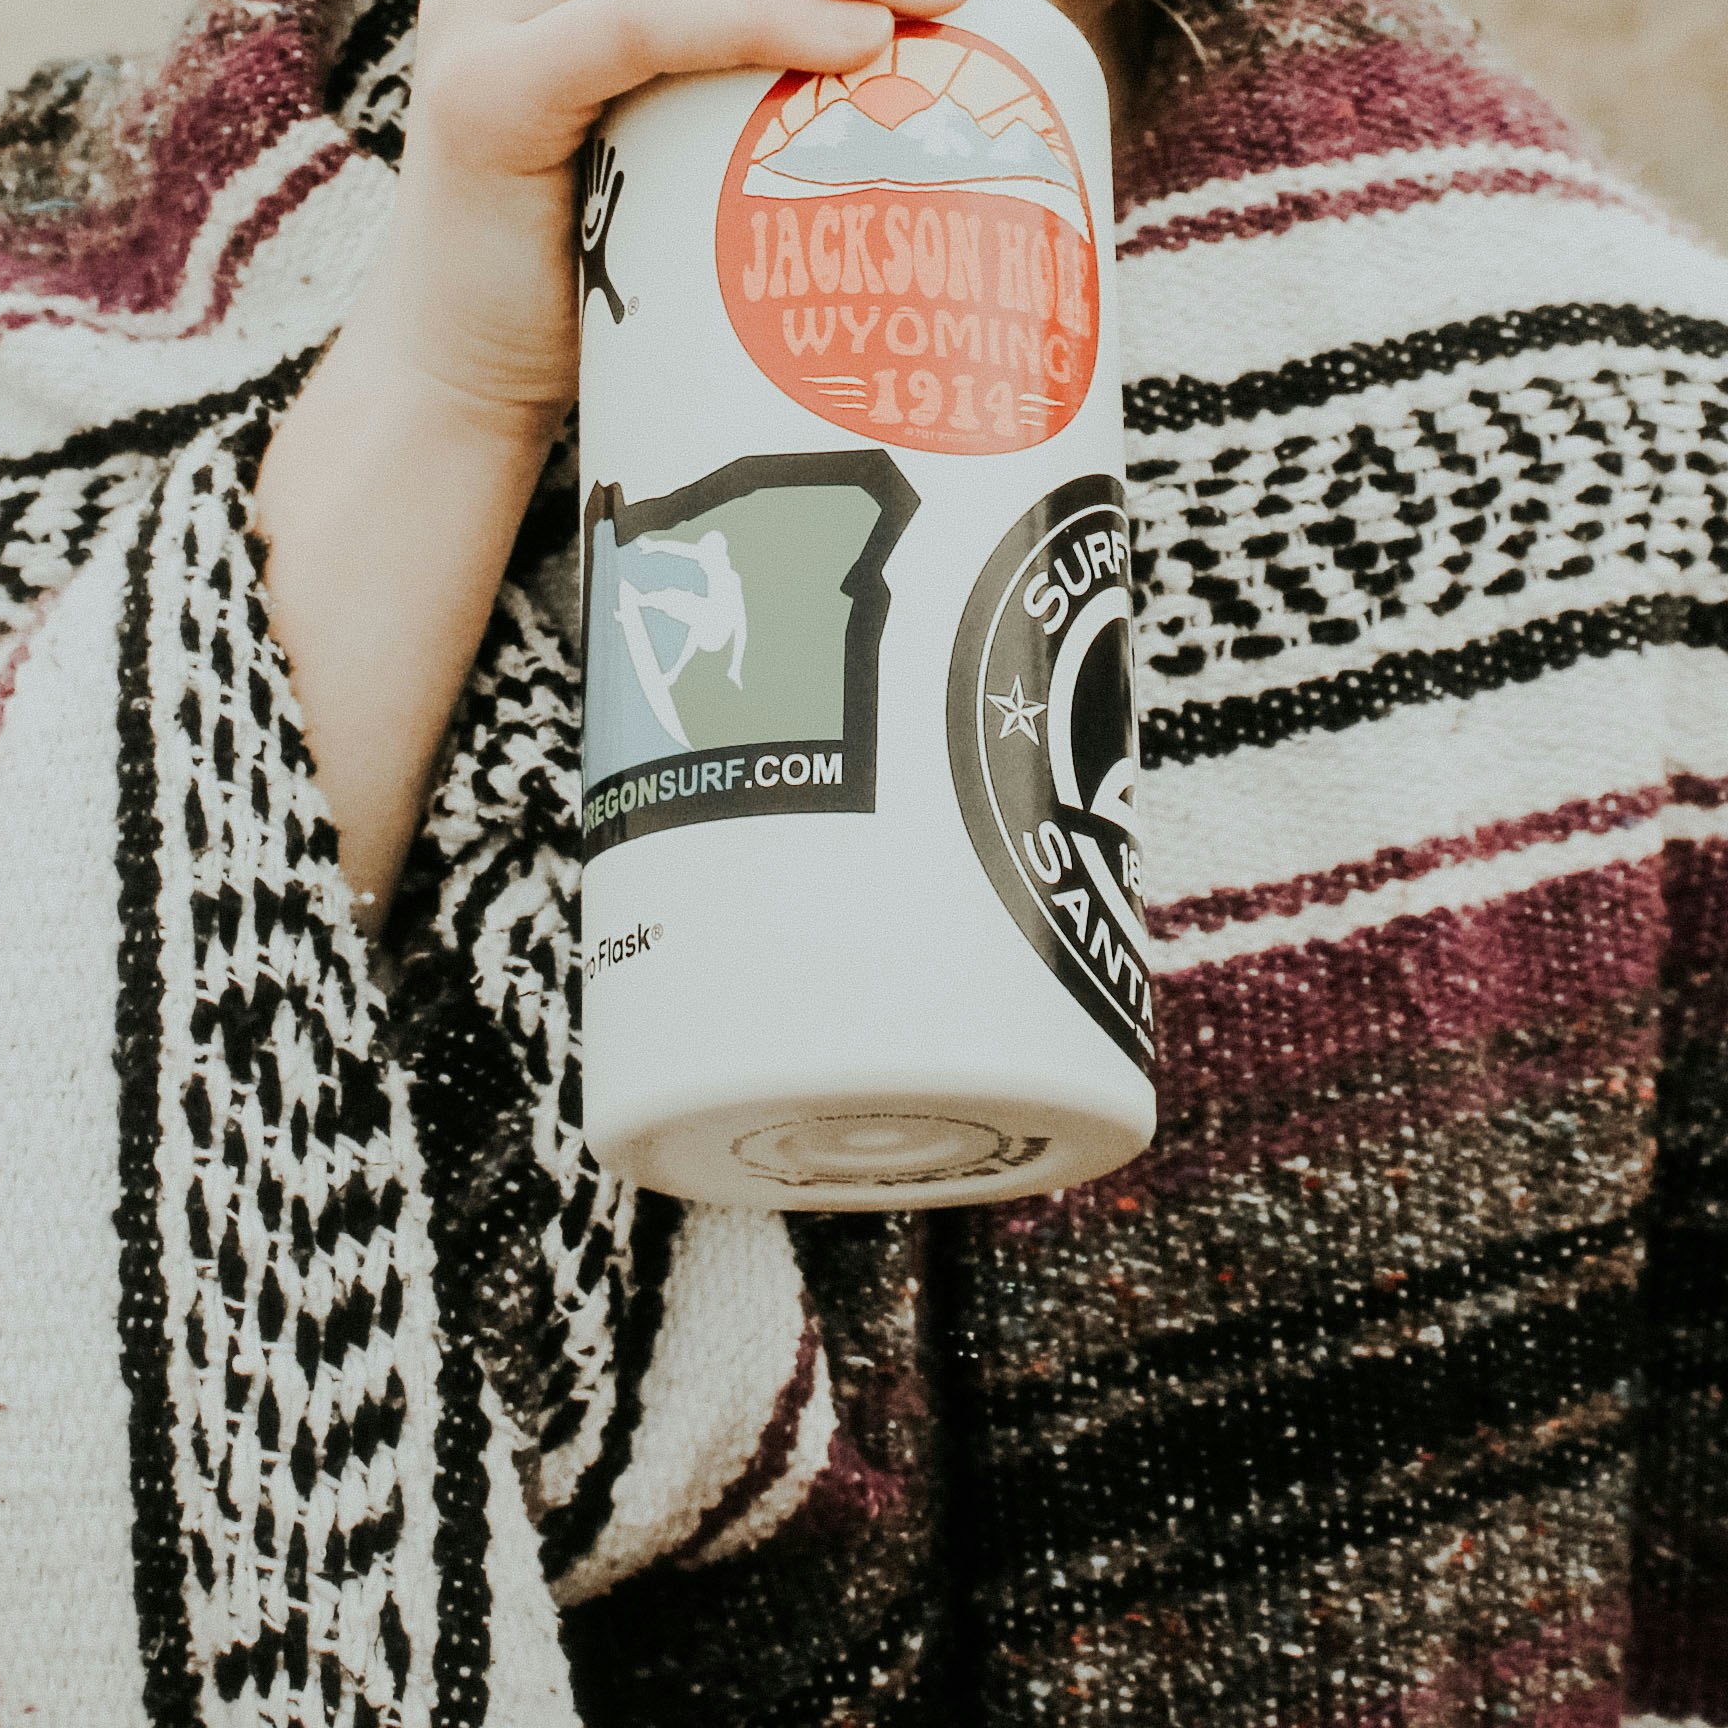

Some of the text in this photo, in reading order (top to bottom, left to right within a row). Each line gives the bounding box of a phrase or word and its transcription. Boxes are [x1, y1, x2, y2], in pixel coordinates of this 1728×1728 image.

[742, 204, 1092, 338] JACKSON HOLE
[781, 305, 1075, 384] WYOMING
[867, 367, 1019, 438] 1914
[1022, 819, 1154, 1032] SANTA
